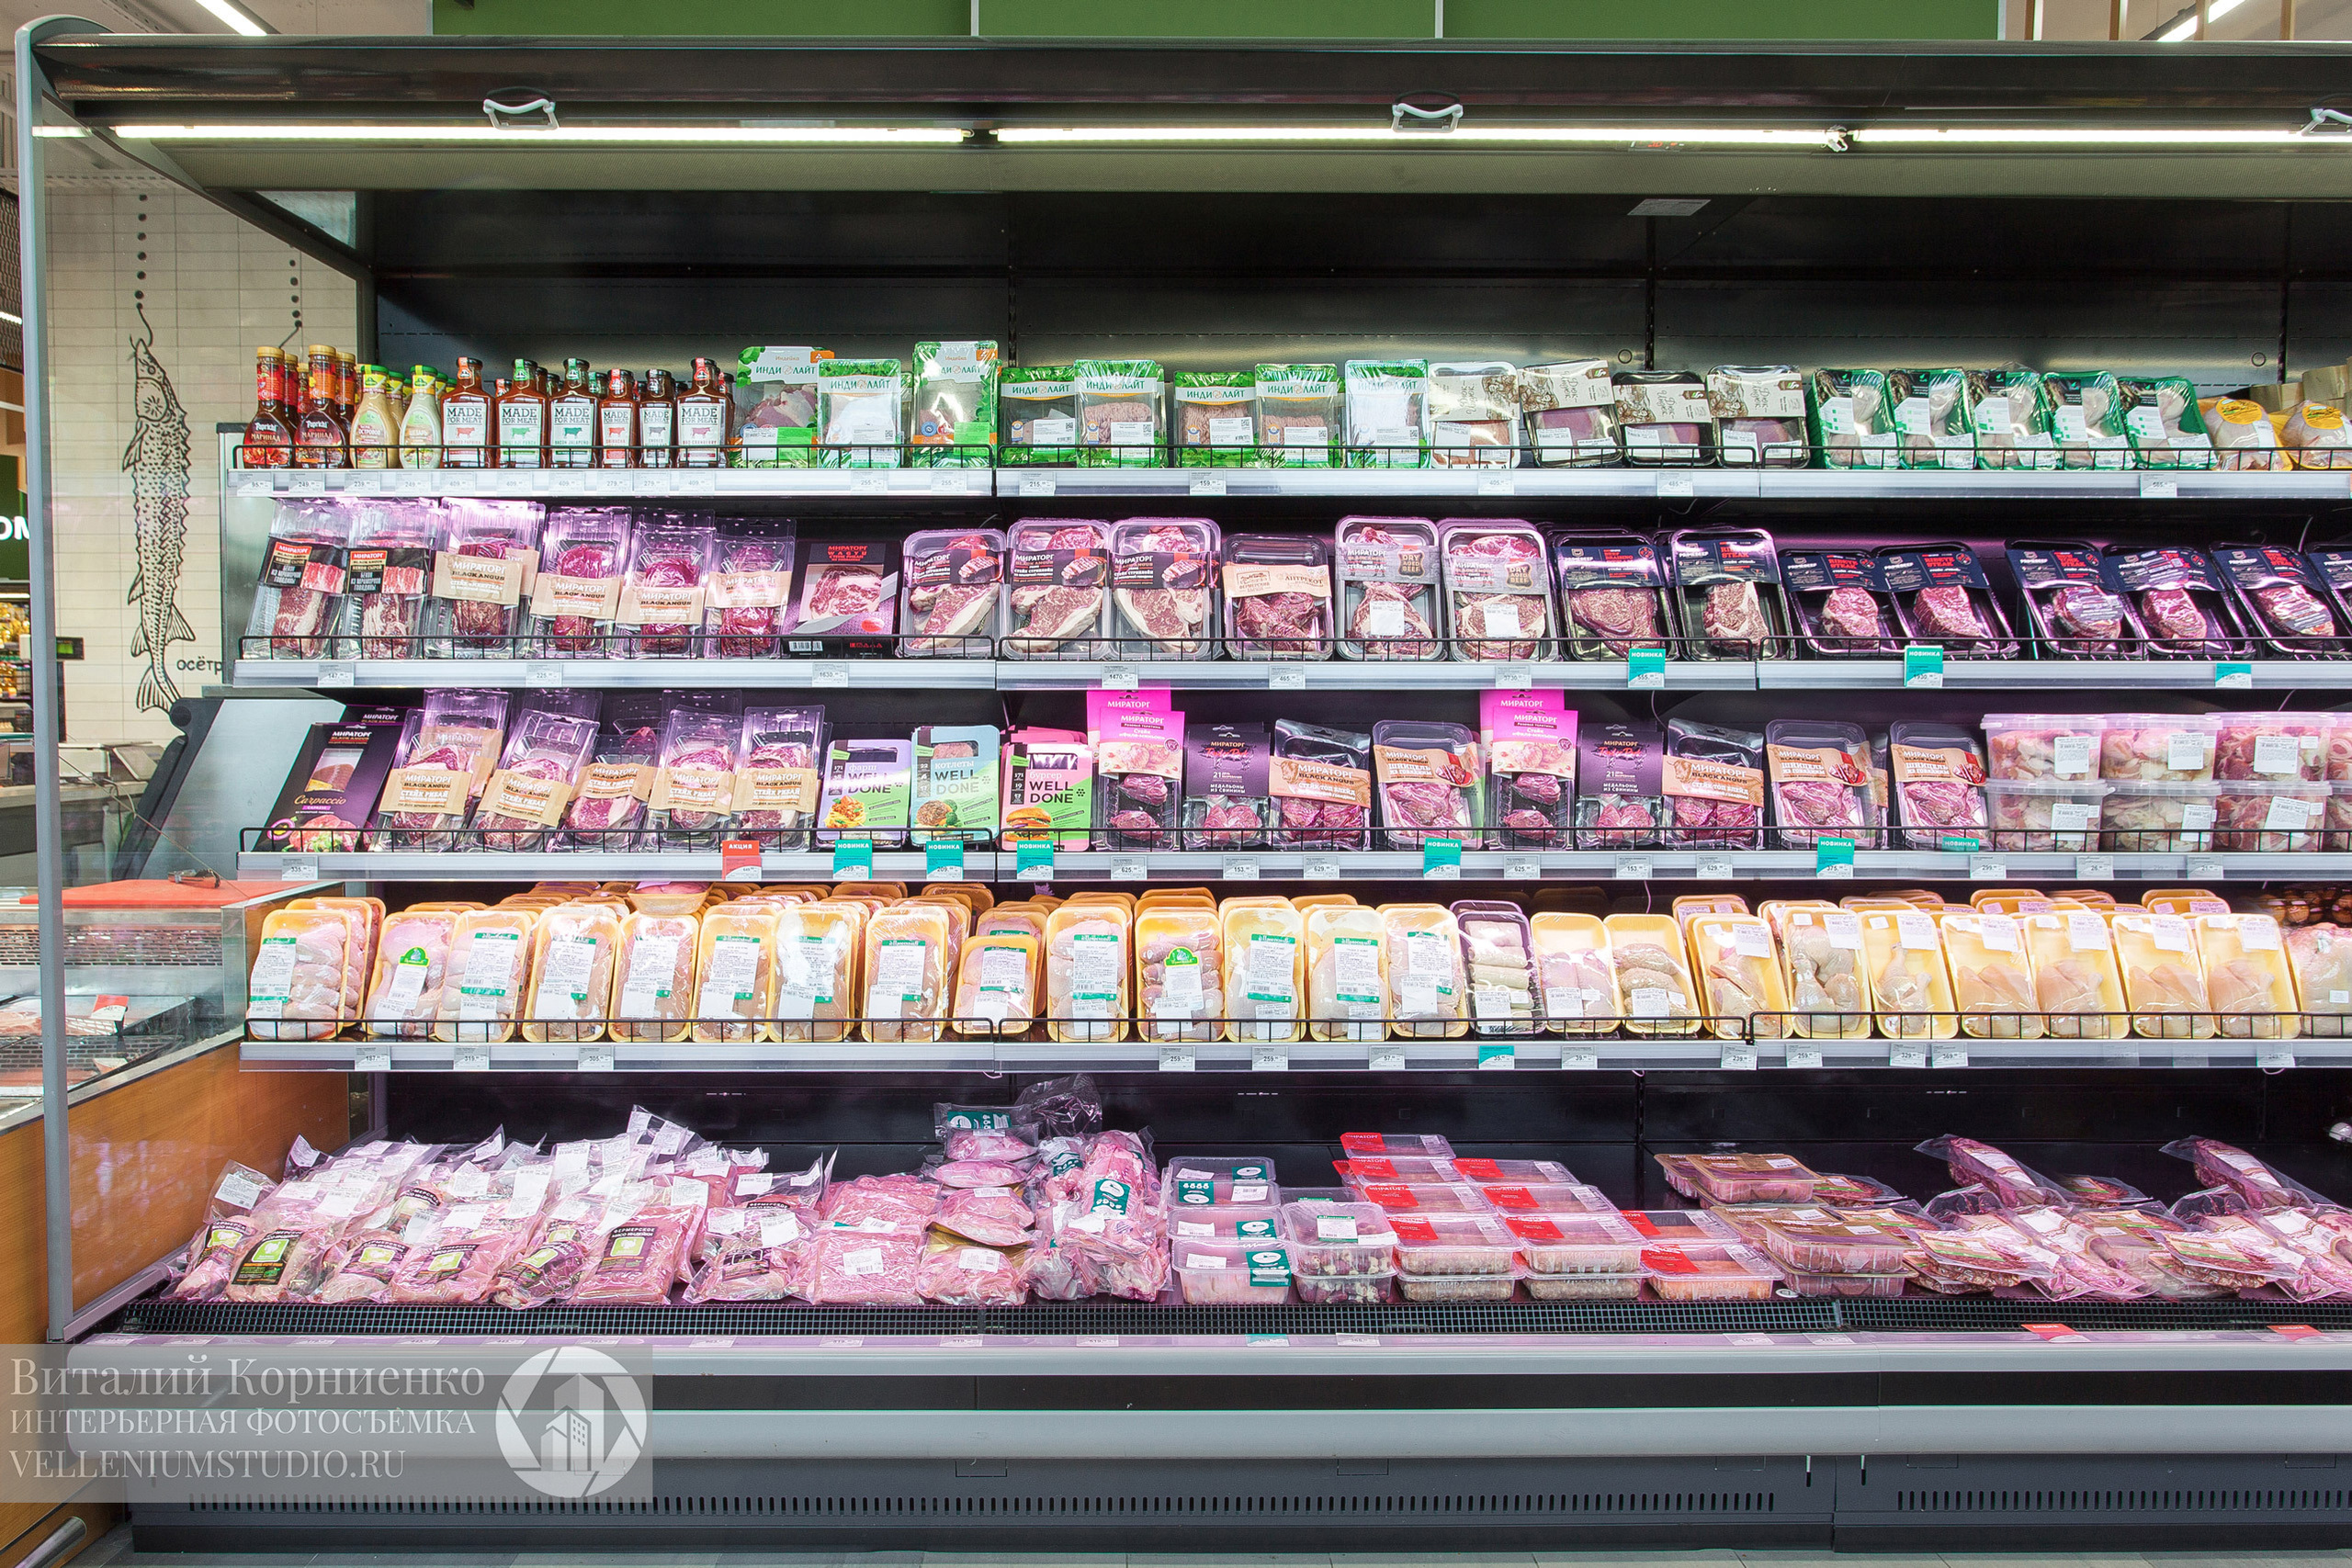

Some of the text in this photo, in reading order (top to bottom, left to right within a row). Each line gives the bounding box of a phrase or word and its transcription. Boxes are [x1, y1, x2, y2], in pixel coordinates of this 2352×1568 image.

[447, 408, 482, 417] MADE
[503, 408, 537, 417] MADE
[555, 408, 589, 417] MADE
[682, 408, 717, 417] MADE
[278, 545, 310, 554] МИРАТОРГ
[914, 554, 951, 566] МИРАТОРГ
[453, 561, 506, 573] МИРАТОРГ
[727, 577, 775, 585] МИРАТОРГ
[556, 582, 606, 592] МИРАТОРГ
[641, 592, 691, 601] МИРАТОРГ
[177, 656, 222, 674] осётр
[1121, 716, 1164, 724] МИРАТОРГ
[1514, 715, 1557, 723] МИРАТОРГ
[1386, 751, 1427, 760] МИРАТОРГ
[1780, 750, 1820, 761] МИРАТОРГ
[1904, 750, 1945, 761] МИРАТОРГ
[594, 767, 639, 775] МИРАТОРГ
[849, 764, 876, 773] фарш
[1298, 764, 1353, 778] МИРАТОРГ
[1691, 763, 1747, 778] МИРАТОРГ
[404, 774, 452, 783] МИРАТОРГ
[673, 773, 718, 782] МИРАТОРГ
[756, 773, 802, 782] МИРАТОРГ
[934, 770, 978, 781] WELL
[1030, 772, 1062, 780] бургер
[1692, 773, 1747, 784] BLACK ANGUS
[1326, 776, 1354, 785] ANGUS
[507, 778, 552, 793] МИРАТОРГ
[848, 784, 891, 794] DONE
[937, 783, 979, 795] DONE
[1030, 781, 1073, 791] WELL
[294, 795, 346, 805] Carpaccio
[1030, 794, 1073, 804] DONE
